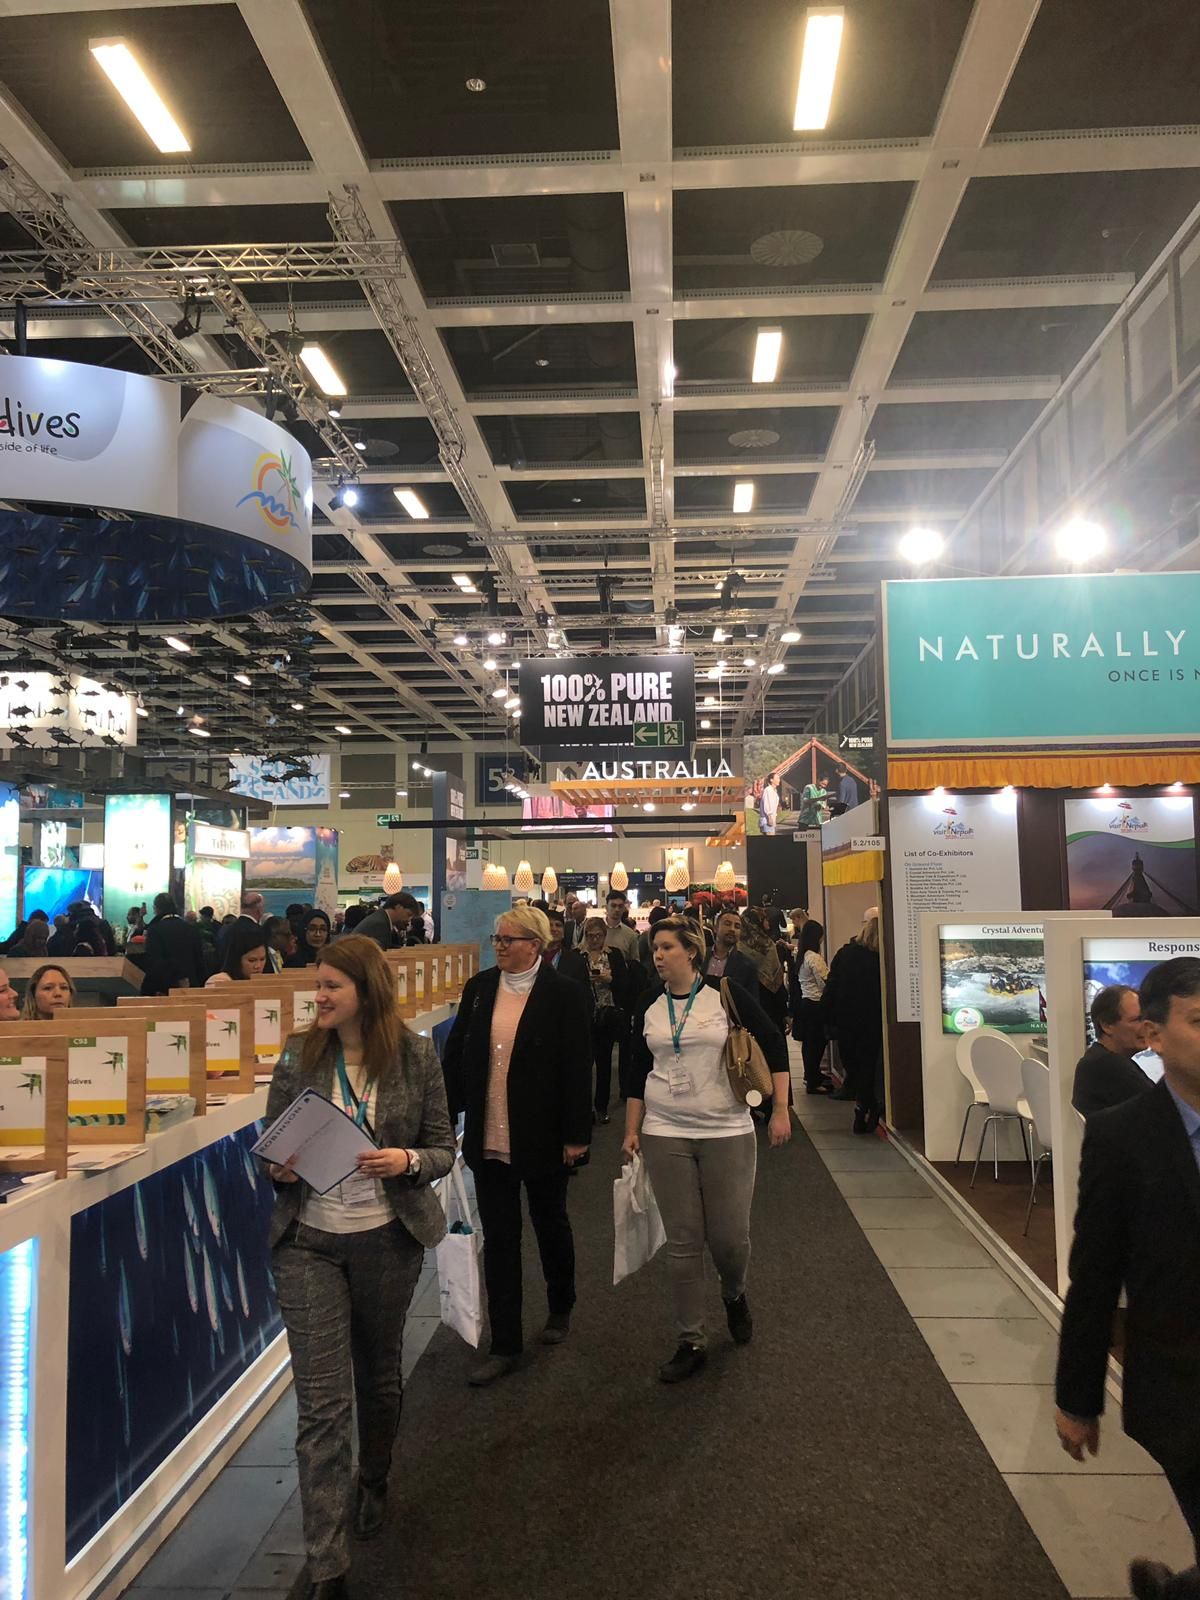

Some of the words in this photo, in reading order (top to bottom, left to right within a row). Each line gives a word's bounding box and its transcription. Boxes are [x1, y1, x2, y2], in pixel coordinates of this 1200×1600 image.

[25, 443, 38, 452] of
[40, 444, 58, 455] life
[919, 630, 1186, 662] NATURALLY
[541, 673, 606, 703] 100%
[610, 671, 673, 701] PURE
[1108, 669, 1160, 682] ONCE
[1169, 669, 1185, 681] IS
[544, 704, 584, 727] NEW
[588, 702, 673, 727] ZEALAND
[582, 758, 735, 781] AUSTRALIA
[981, 926, 1010, 935] Crystal
[259, 1106, 302, 1153] ROBINSON
